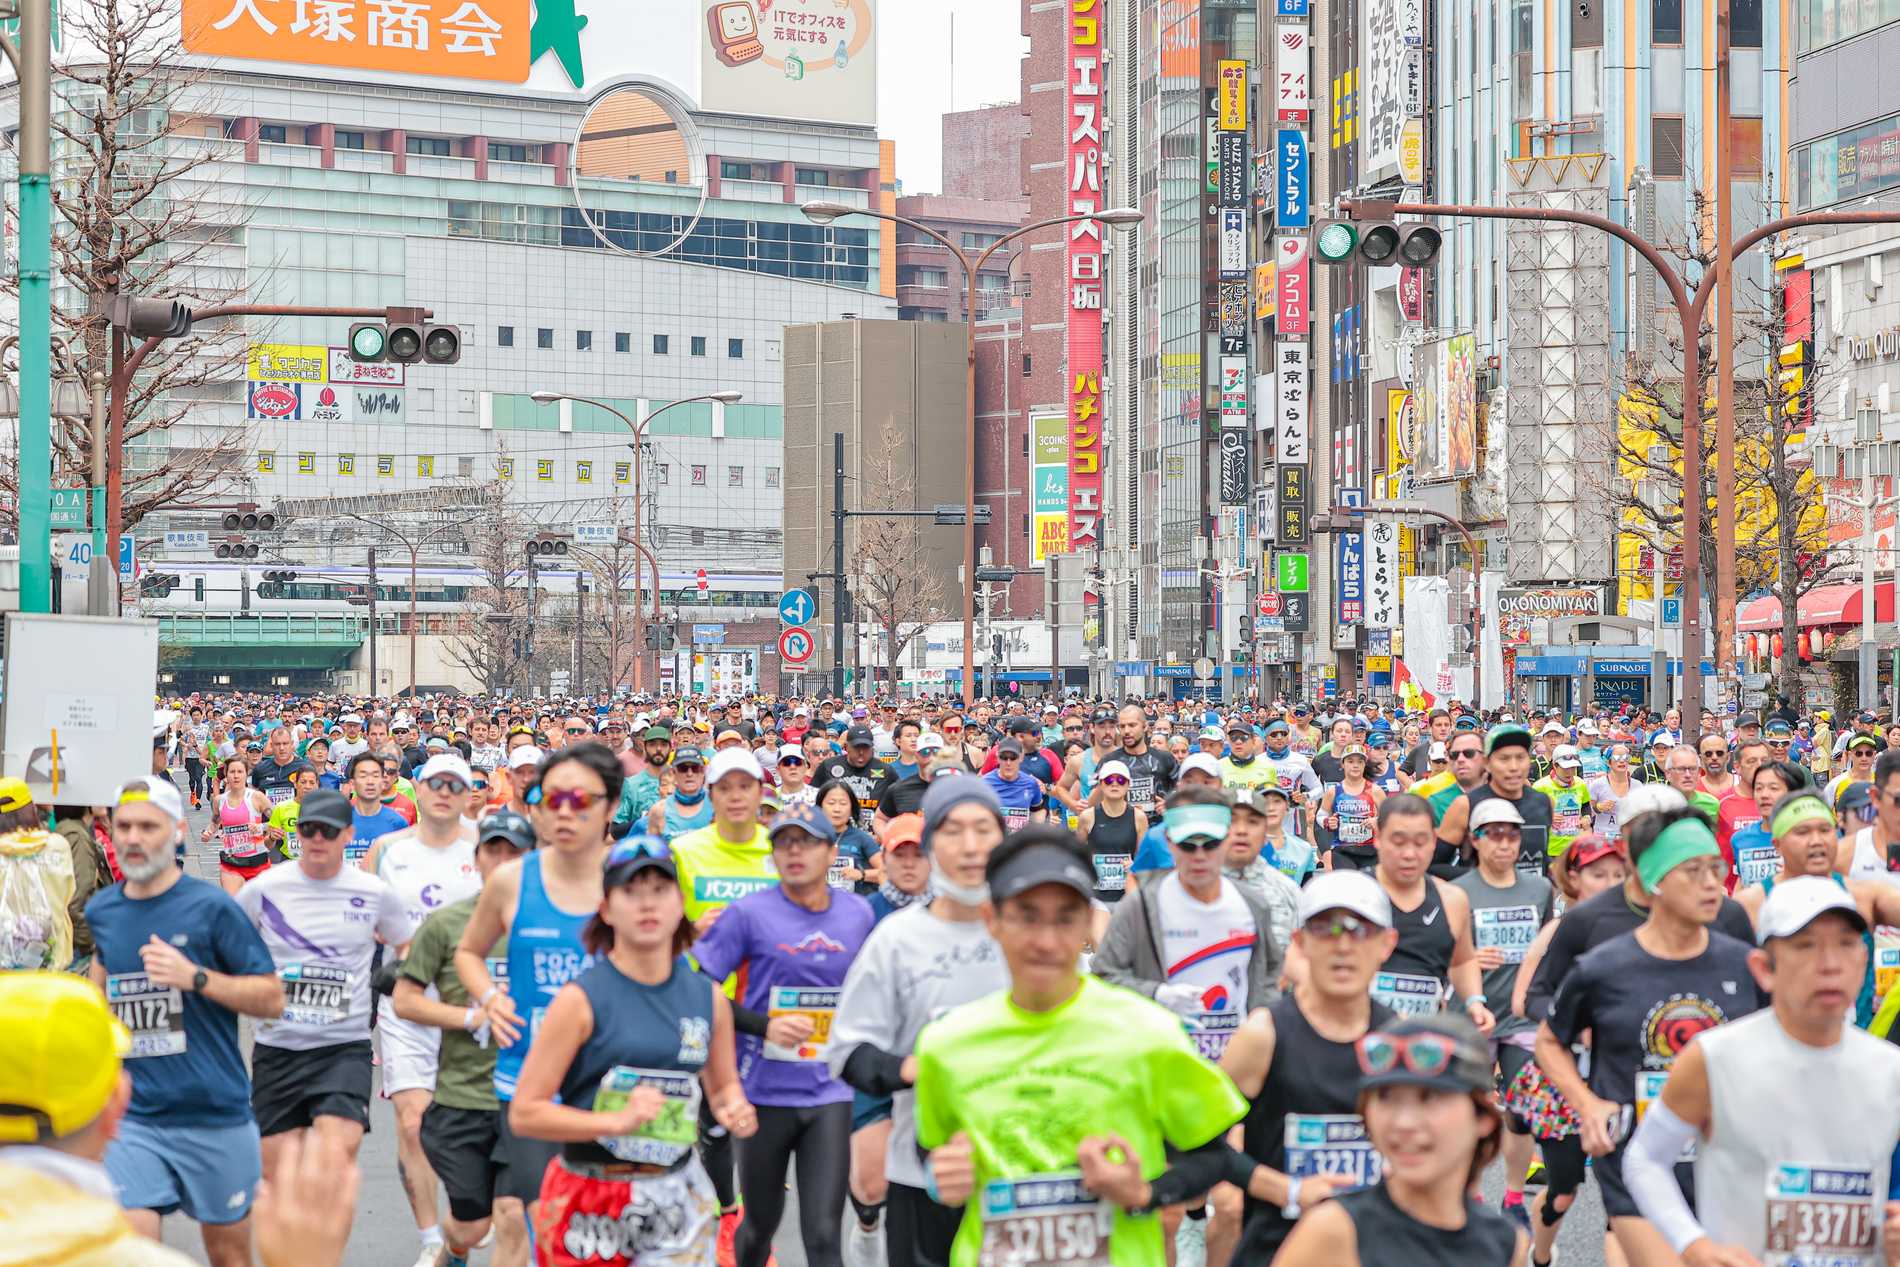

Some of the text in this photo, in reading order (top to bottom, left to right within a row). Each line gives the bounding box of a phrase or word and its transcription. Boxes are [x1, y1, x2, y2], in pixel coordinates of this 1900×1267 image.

[774, 10, 846, 29] ITでオフィスを
[773, 26, 828, 44] 元気にする
[1287, 112, 1299, 121] 5F
[1232, 137, 1242, 201] BUZZ STAND
[1286, 142, 1300, 215] セントラル
[1070, 56, 1101, 311] エスパス日拓
[1286, 274, 1300, 317] アコム
[1286, 321, 1299, 330] 3F
[1225, 339, 1244, 351] 7F
[1073, 369, 1099, 474] パチンコ
[1286, 471, 1300, 498] 買取
[1041, 521, 1065, 540] ABC
[1286, 511, 1300, 538] 販売
[70, 543, 92, 565] 40
[1041, 542, 1065, 554] MART
[1286, 557, 1298, 585] レイク
[1499, 596, 1598, 613] OKONOMIYAKI
[1667, 601, 1676, 614] P
[1600, 664, 1648, 672] SUBNADE
[1492, 927, 1532, 945] 30826
